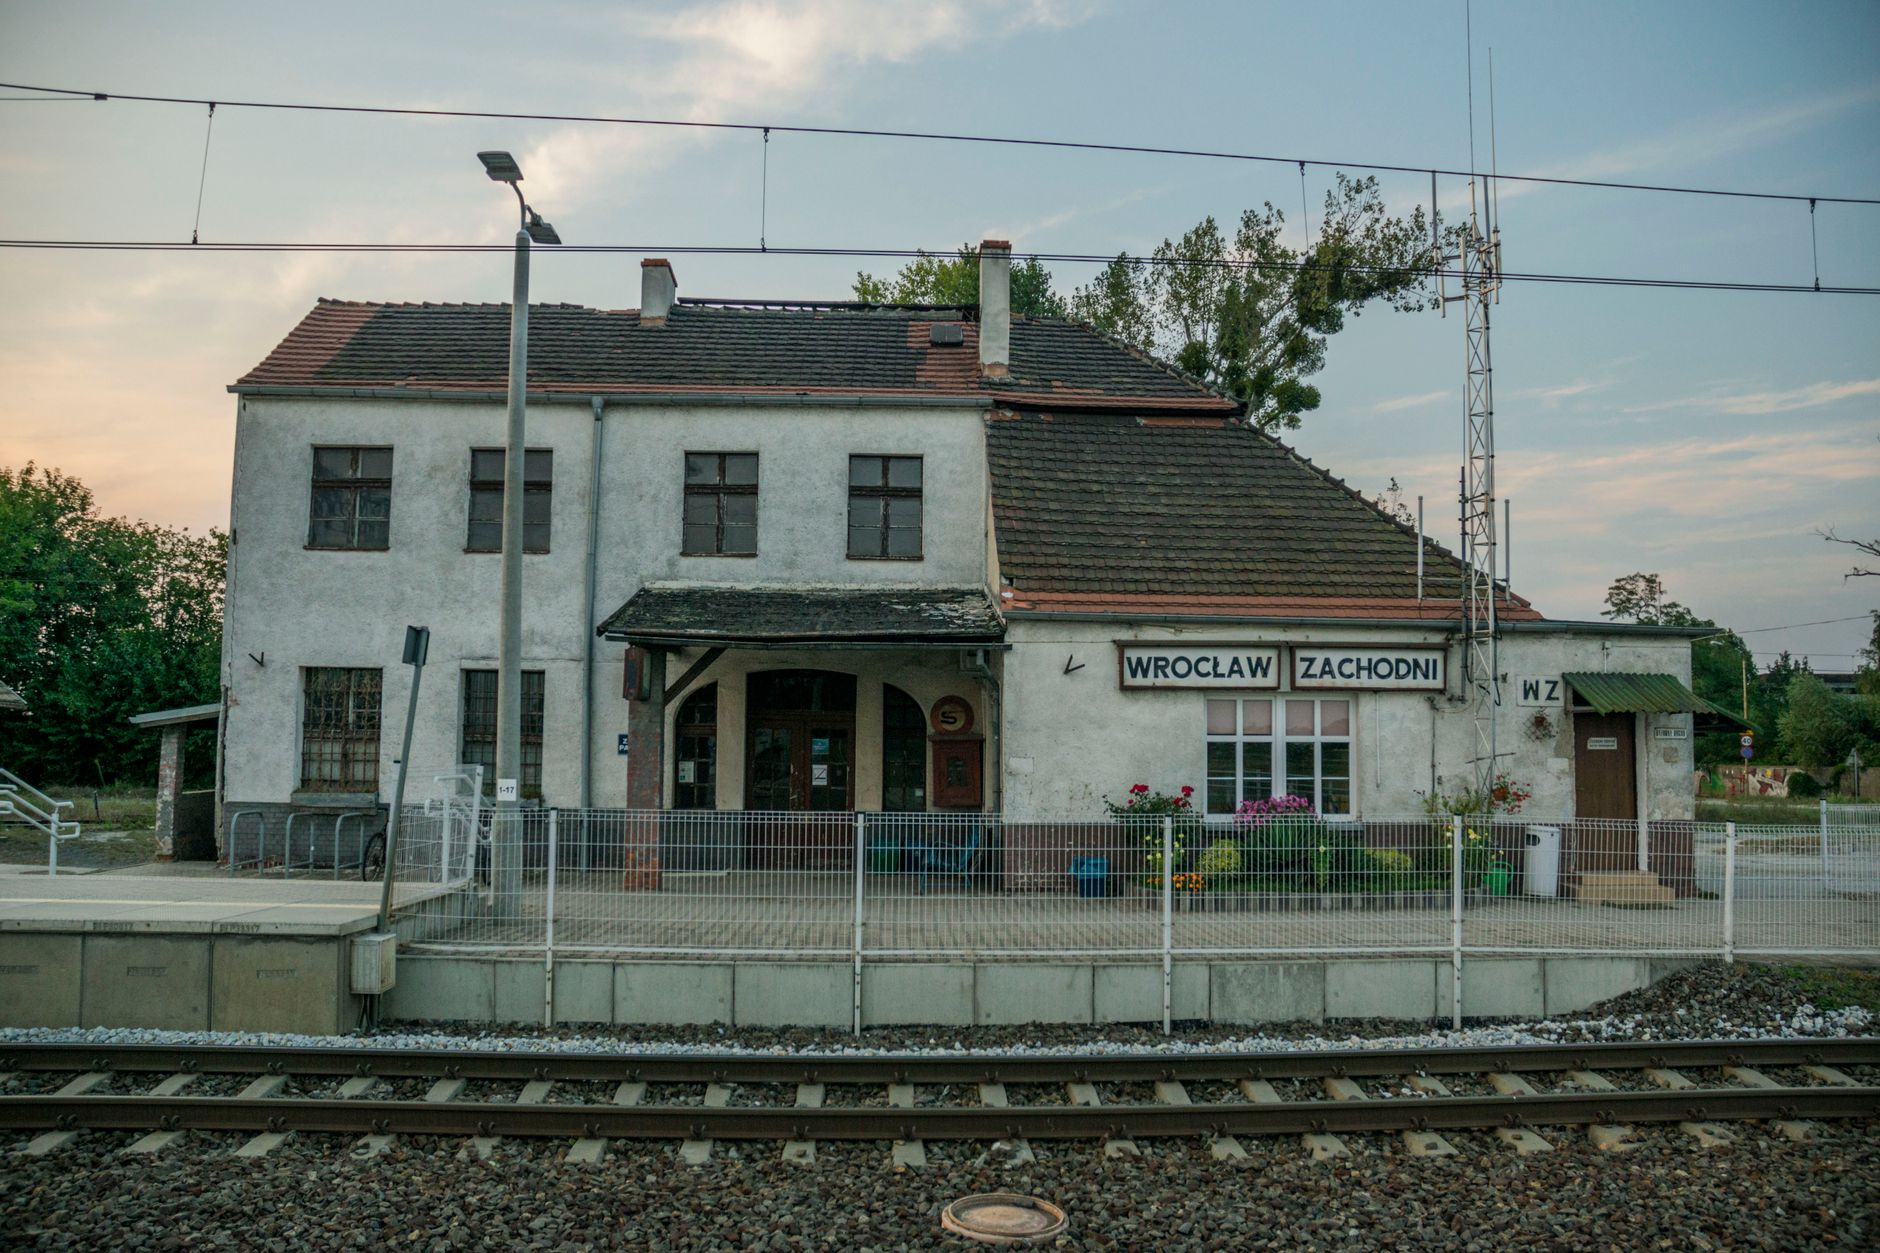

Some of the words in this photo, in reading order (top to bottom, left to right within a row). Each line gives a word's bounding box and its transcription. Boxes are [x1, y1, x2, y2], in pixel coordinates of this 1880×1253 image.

[1126, 656, 1273, 679] WROCŁAW
[1299, 657, 1438, 680] ZACHODNI
[499, 786, 514, 794] 1-17
